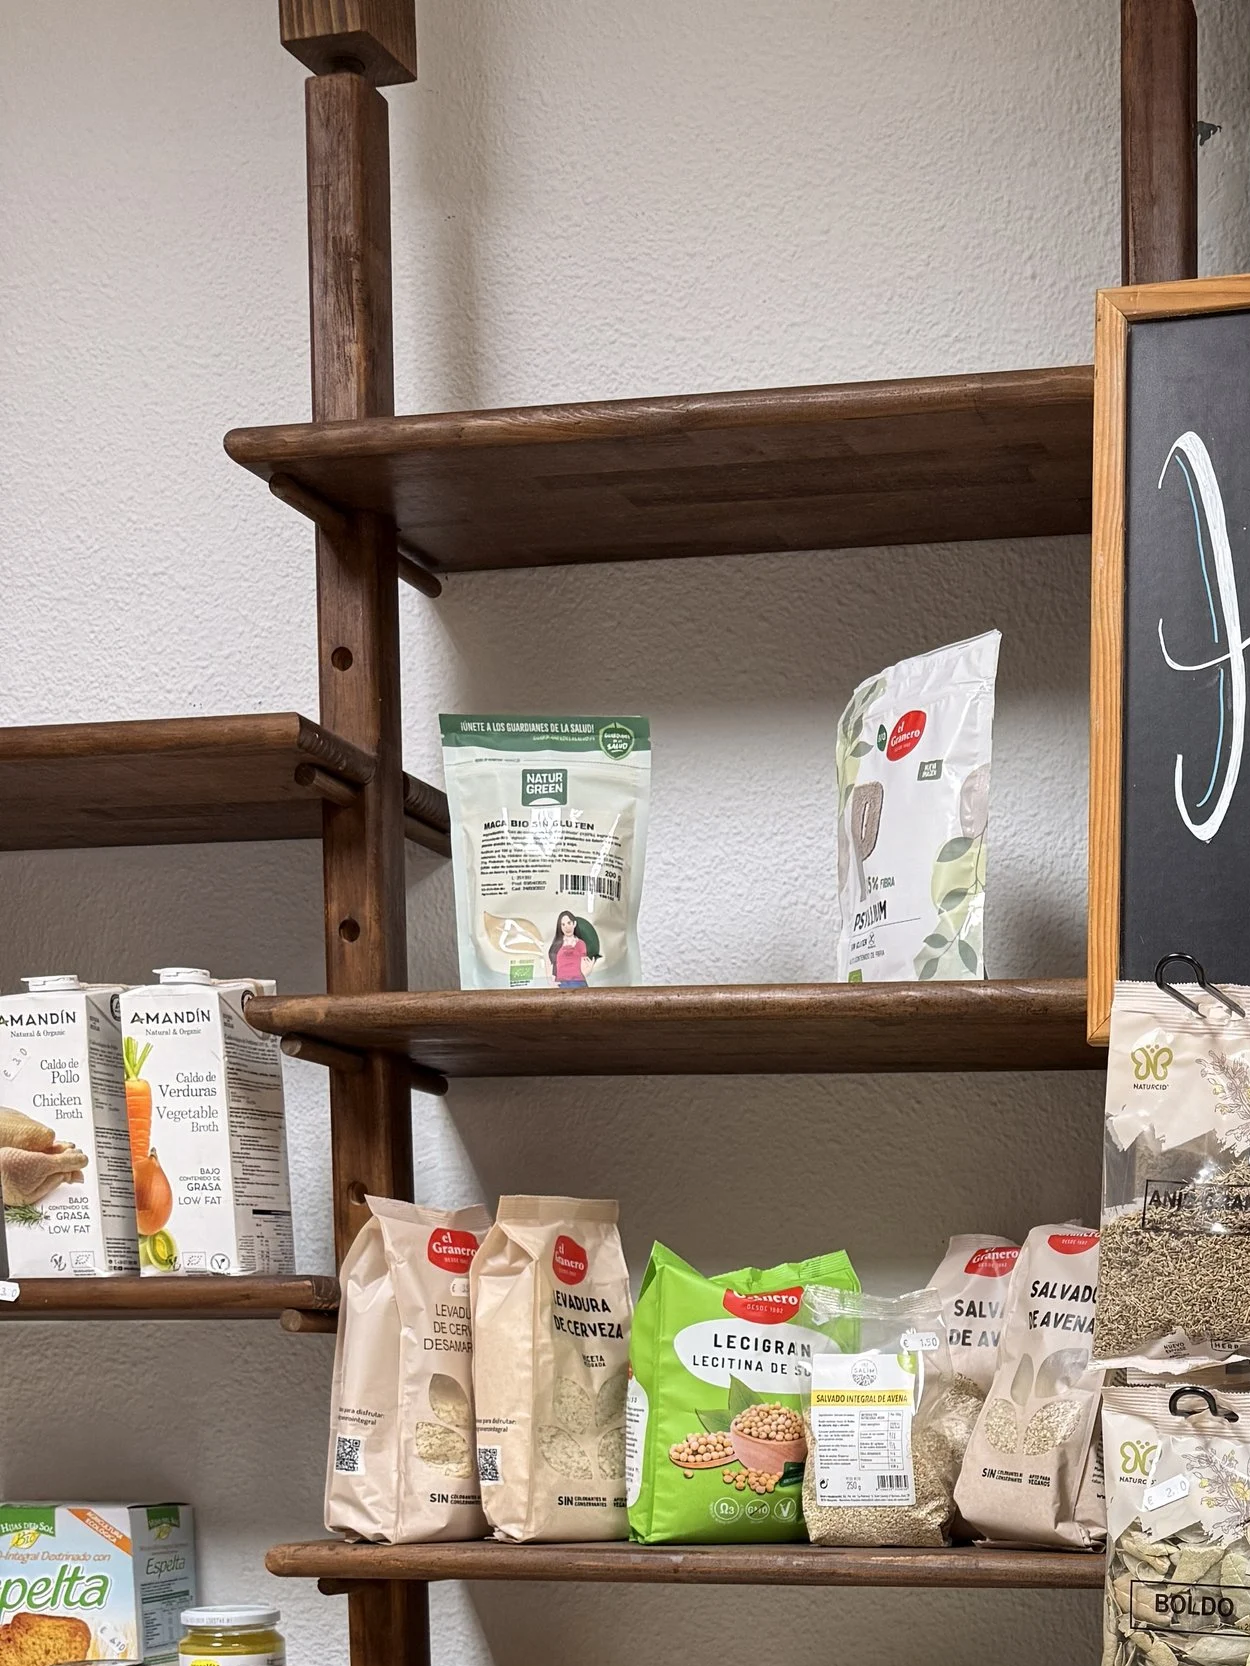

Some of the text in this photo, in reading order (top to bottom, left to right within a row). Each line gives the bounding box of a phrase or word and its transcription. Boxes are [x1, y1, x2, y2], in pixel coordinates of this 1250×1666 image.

[487, 723, 491, 731] A
[492, 722, 505, 732] LOS
[507, 723, 549, 732] GUARDIANES
[550, 723, 559, 732] DE
[561, 723, 569, 732] LA
[570, 723, 594, 733] SALUD!
[527, 773, 563, 782] NATUR
[527, 783, 563, 794] GREEN
[131, 1008, 211, 1025] AMANDÍN
[145, 1028, 171, 1036] Natural
[51, 1070, 80, 1084] Pollo
[176, 1072, 216, 1083] Caldo de
[159, 1084, 217, 1098] Verduras
[33, 1094, 82, 1106] Chicken
[156, 1106, 218, 1120] Vegetable
[191, 1122, 219, 1132] Broth
[187, 1183, 221, 1191] GRASA
[178, 1197, 200, 1205] LOW
[713, 1334, 811, 1356] LECIGRAN
[692, 1355, 788, 1373] LECITINA DE
[816, 1394, 908, 1403] SALVADO INTEGRAL DE AVENA
[146, 1556, 185, 1575] Espelta
[1155, 1594, 1234, 1618] BOLDO
